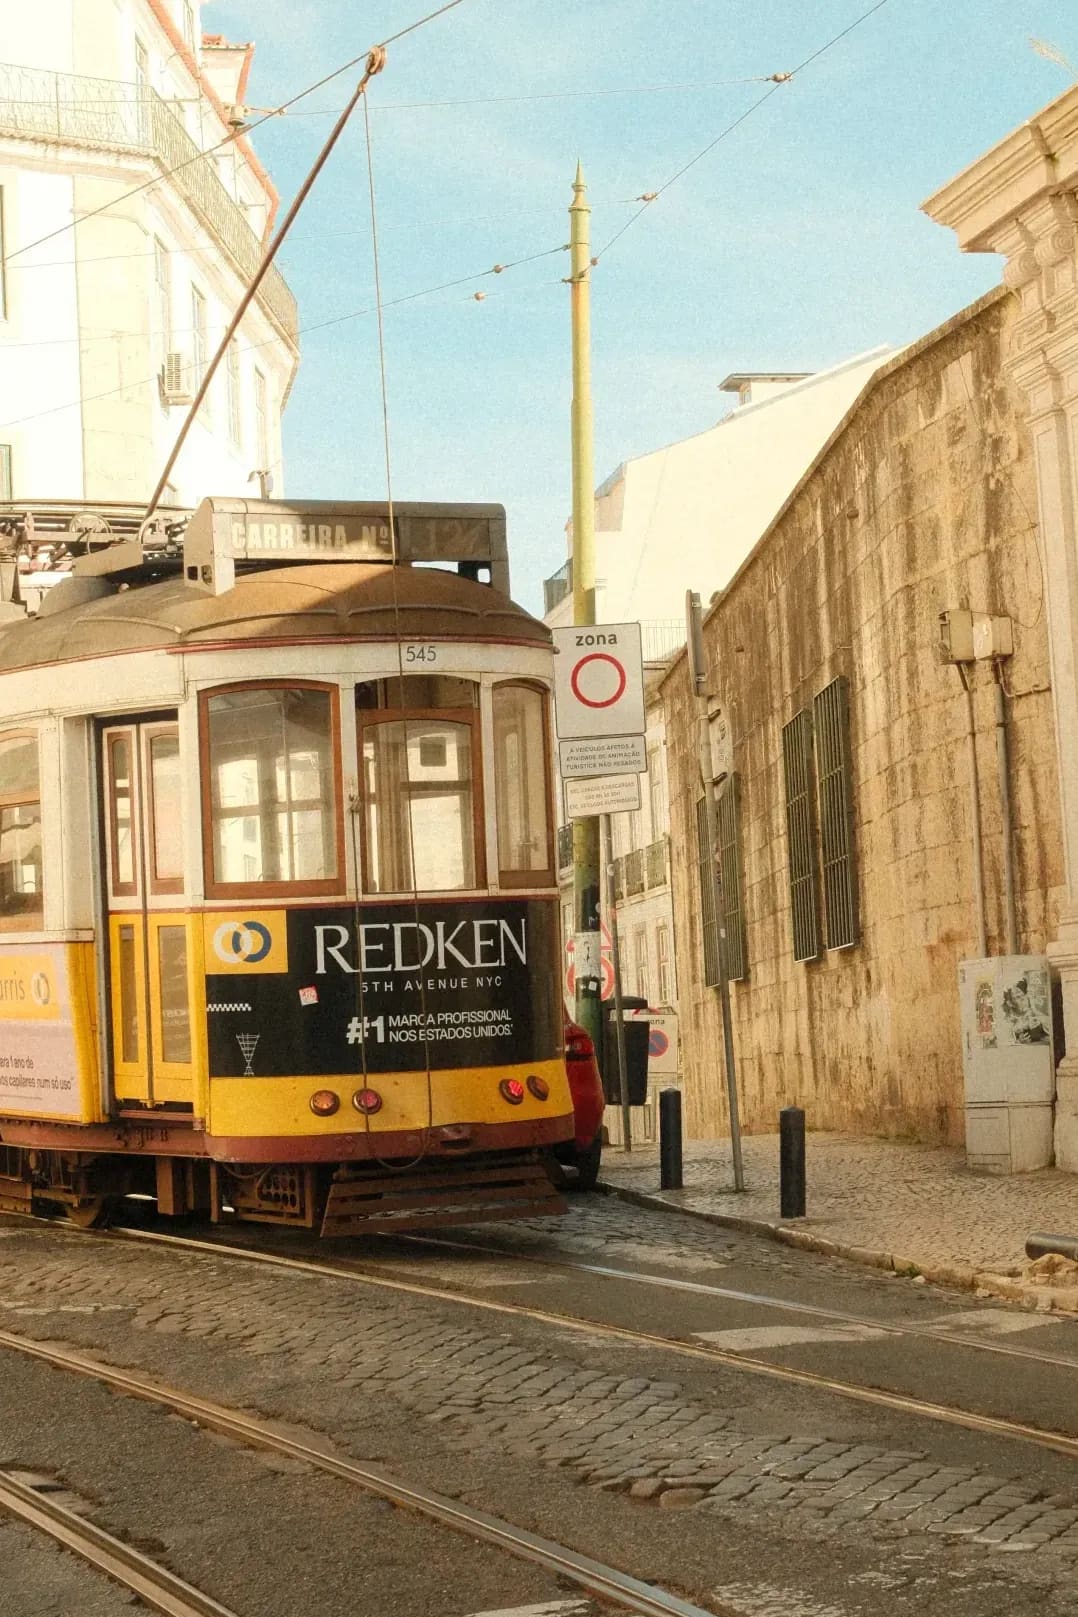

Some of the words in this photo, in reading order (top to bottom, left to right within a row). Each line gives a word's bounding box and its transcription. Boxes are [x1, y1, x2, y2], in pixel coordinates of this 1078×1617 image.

[231, 522, 347, 550] CARREIRA
[575, 633, 618, 646] zona
[406, 645, 437, 662] 545
[314, 919, 527, 974] REDKEN
[361, 981, 394, 993] 5TH
[404, 977, 469, 991] AVENUE
[476, 975, 502, 988] NYC
[388, 1013, 436, 1027] MARCA
[437, 1008, 512, 1025] PROFISSIONAL
[345, 1015, 385, 1044] #1
[389, 1030, 417, 1042] NOS
[418, 1026, 472, 1041] ESTADOS
